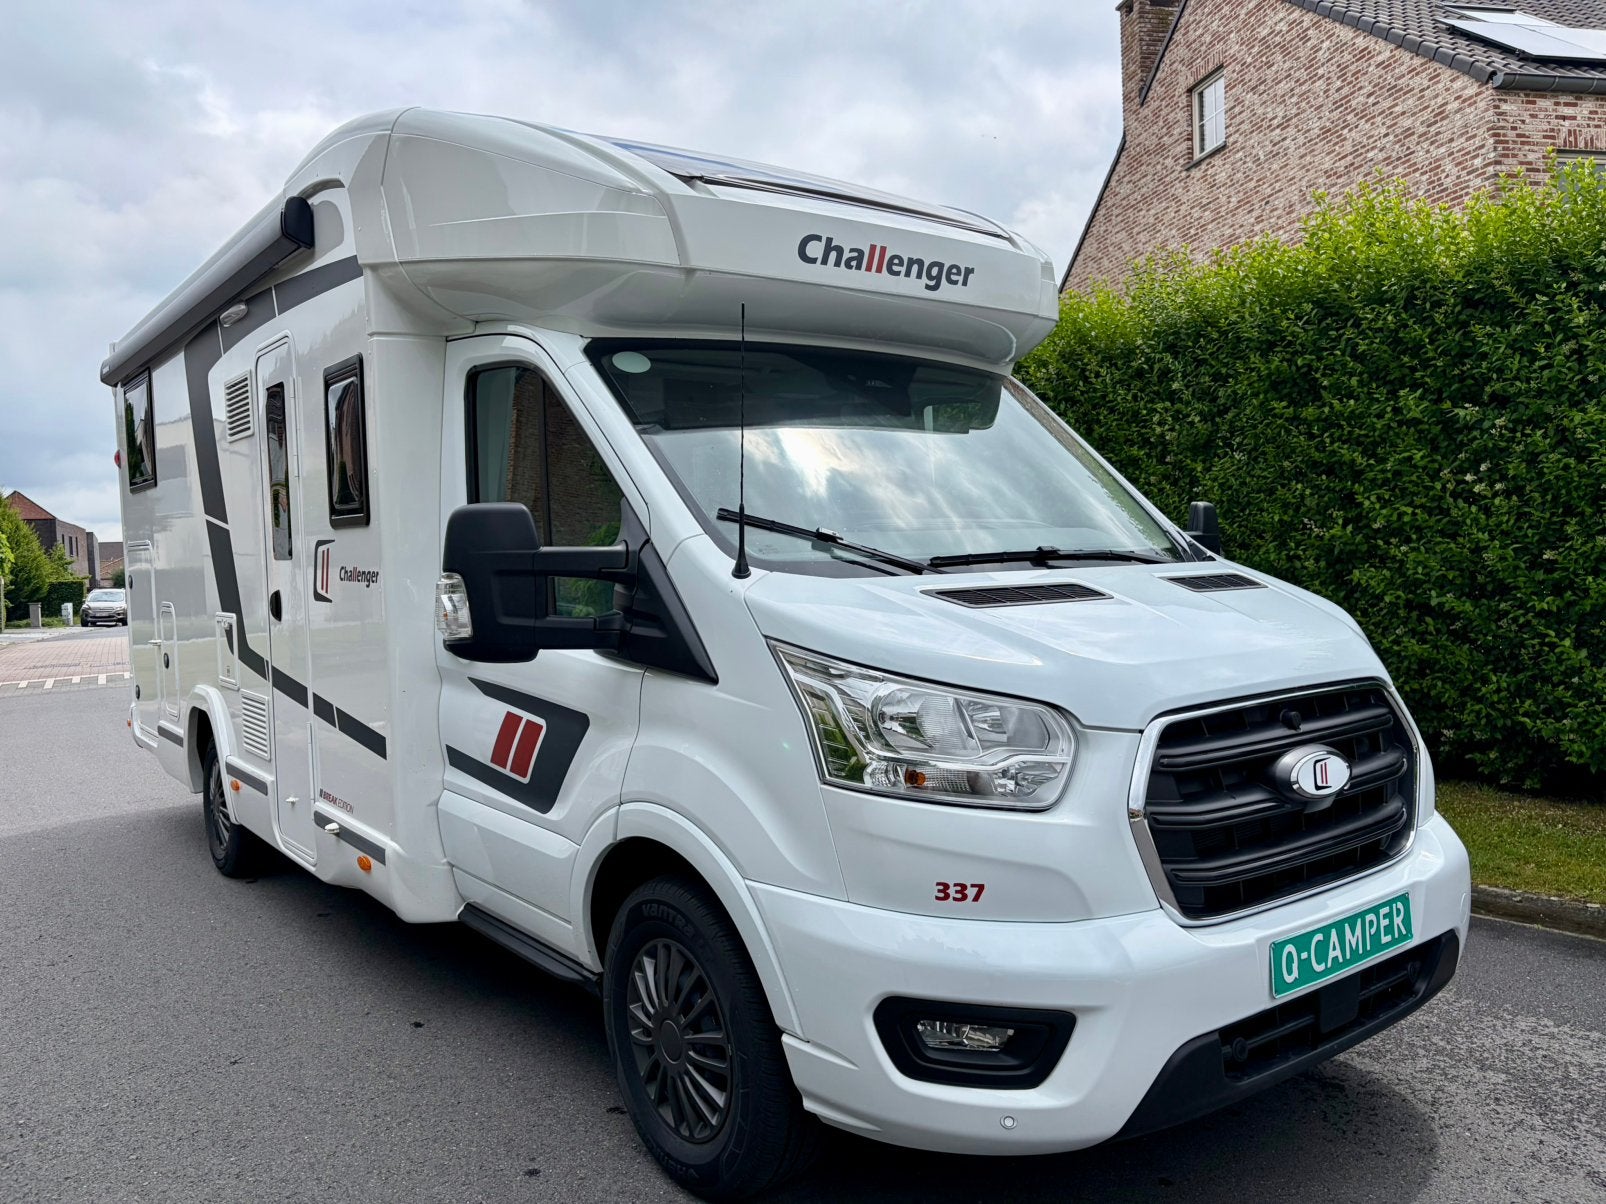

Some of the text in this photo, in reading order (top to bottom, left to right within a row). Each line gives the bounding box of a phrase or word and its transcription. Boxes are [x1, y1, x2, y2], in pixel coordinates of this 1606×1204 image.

[797, 233, 975, 292] Challenger
[339, 565, 379, 588] Challenger
[323, 790, 354, 815] BREAK EDITION
[934, 881, 985, 902] 337
[1281, 901, 1408, 984] Q-CAMPER
